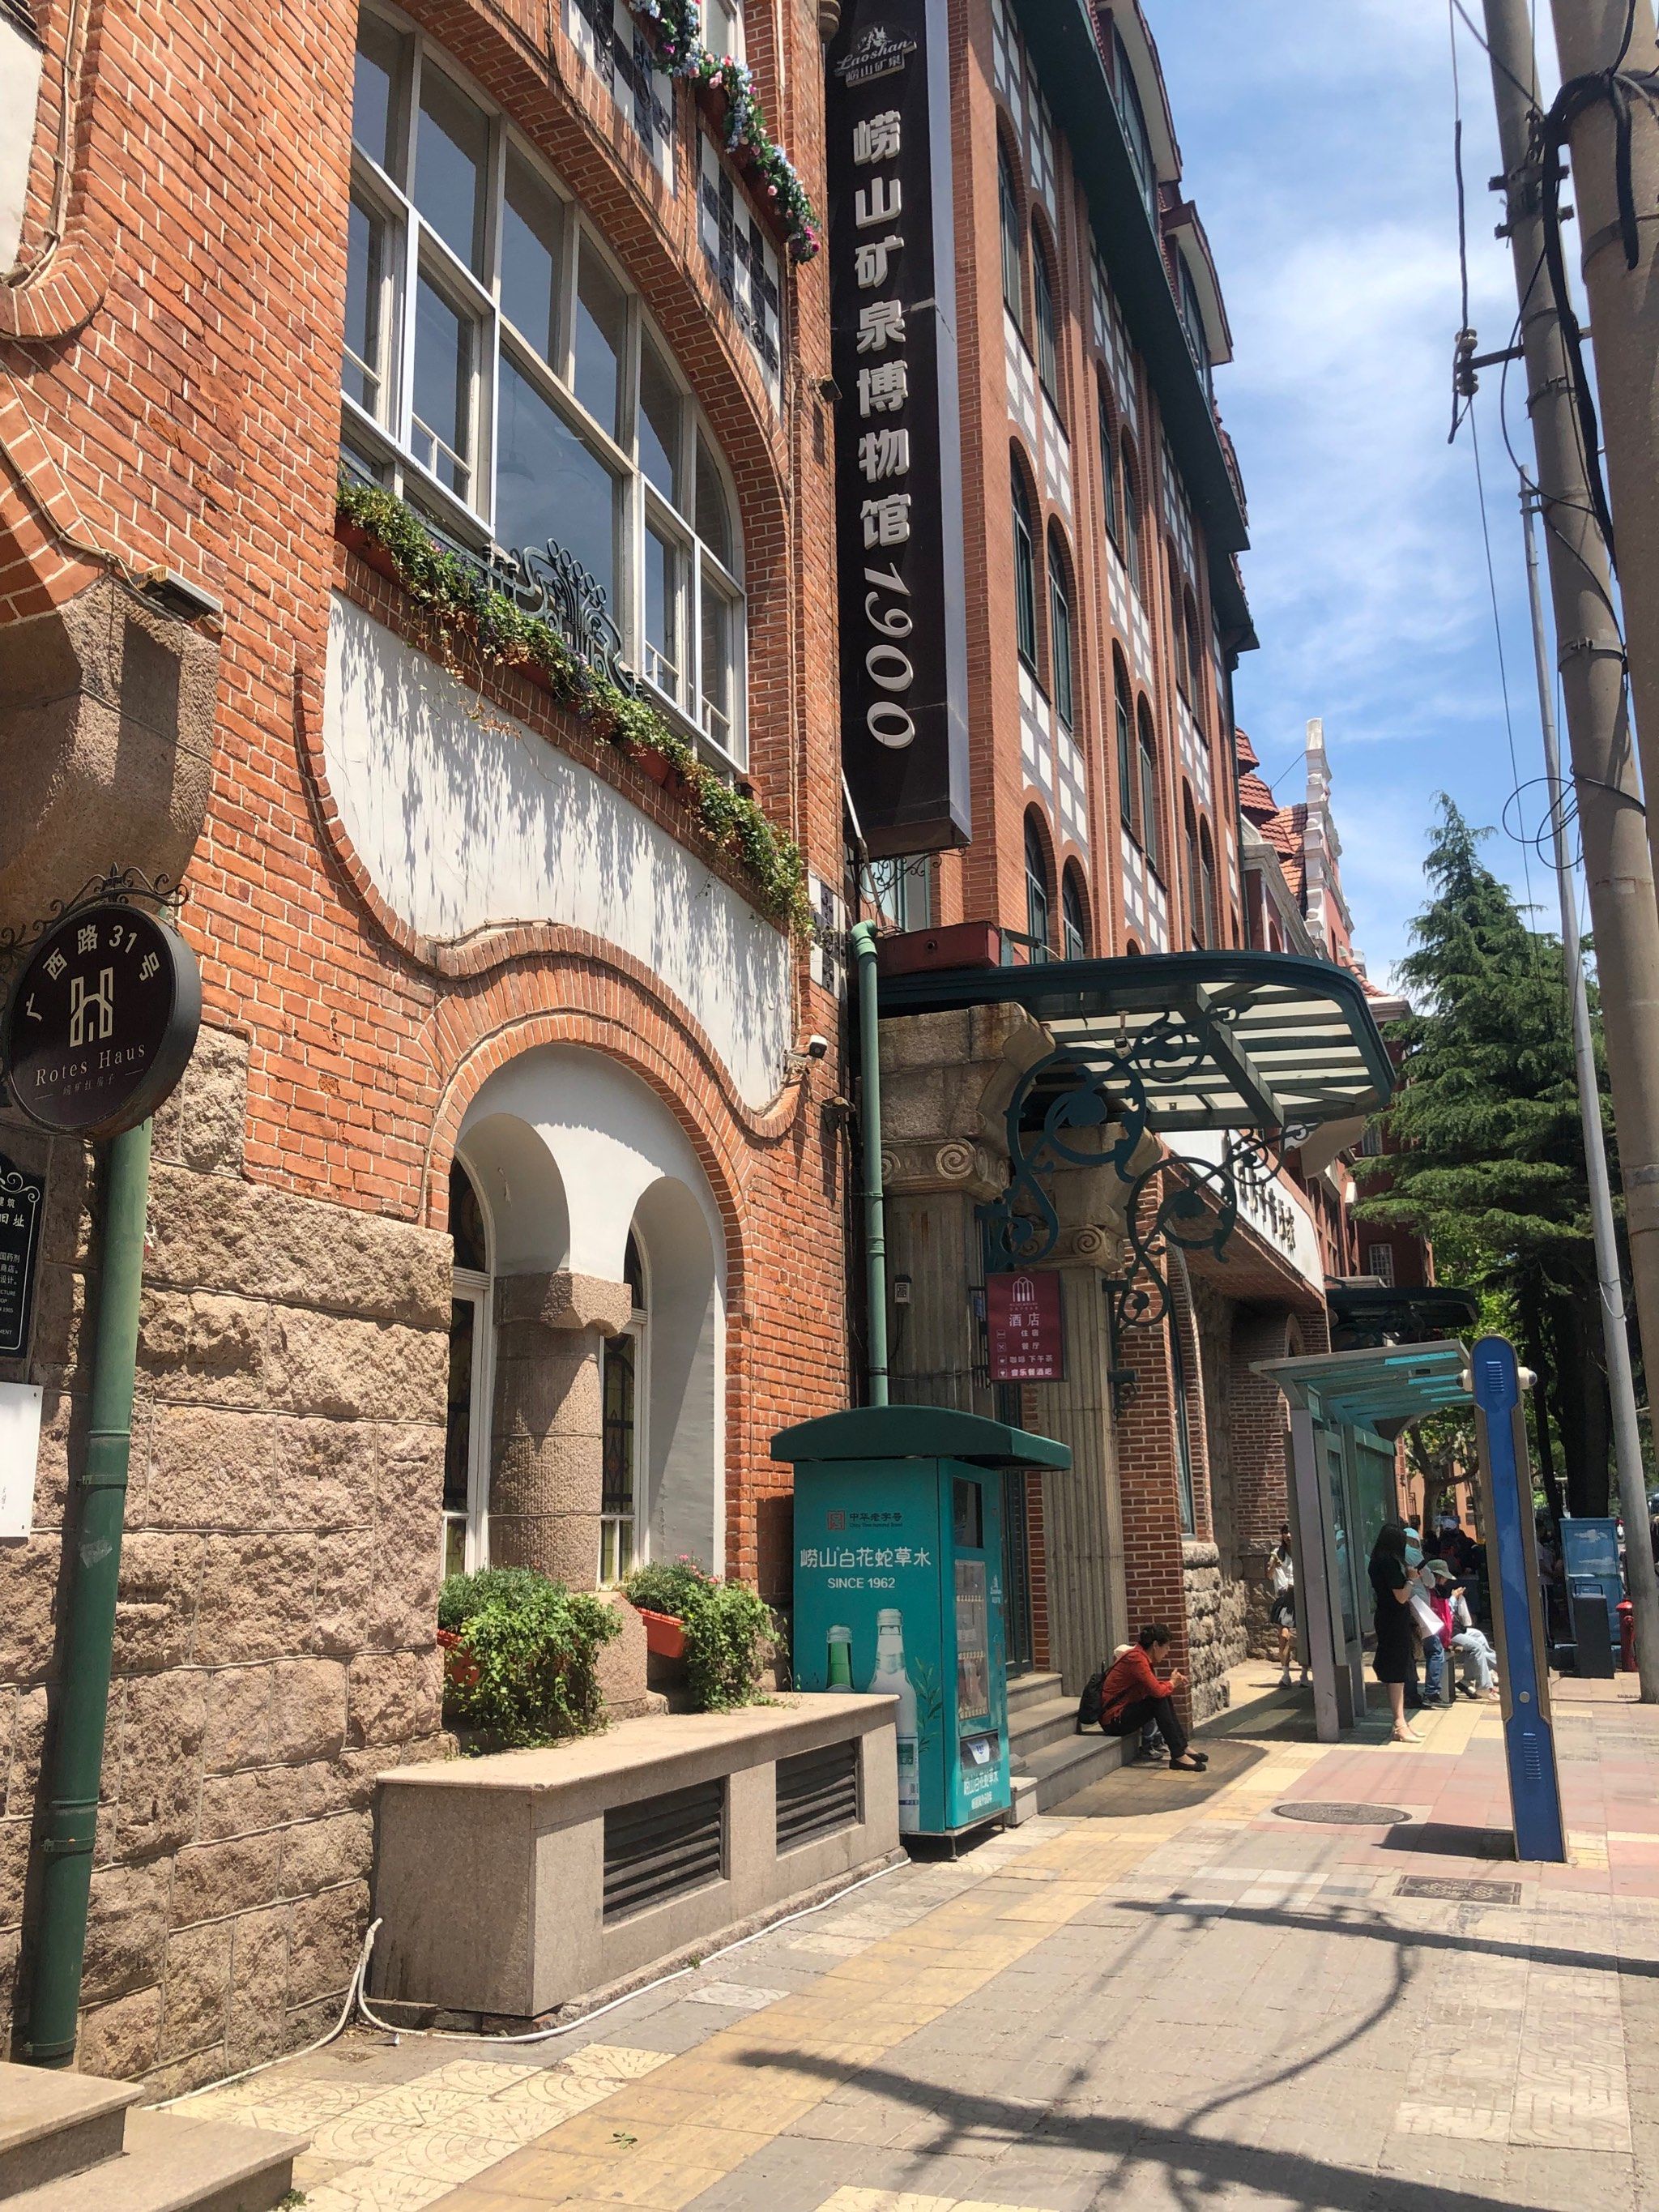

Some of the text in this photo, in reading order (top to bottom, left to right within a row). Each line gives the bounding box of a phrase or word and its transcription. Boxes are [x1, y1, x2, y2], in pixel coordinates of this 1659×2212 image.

[836, 40, 913, 70] Laoshan
[846, 54, 902, 82] 崂山矿泉
[864, 562, 915, 749] 1900
[35, 1044, 145, 1087] Rotes Haus
[1009, 1312, 1040, 1327] 酒店
[800, 1546, 932, 1569] 崂山白花蛇草水
[827, 1577, 896, 1589] SINCE 1962
